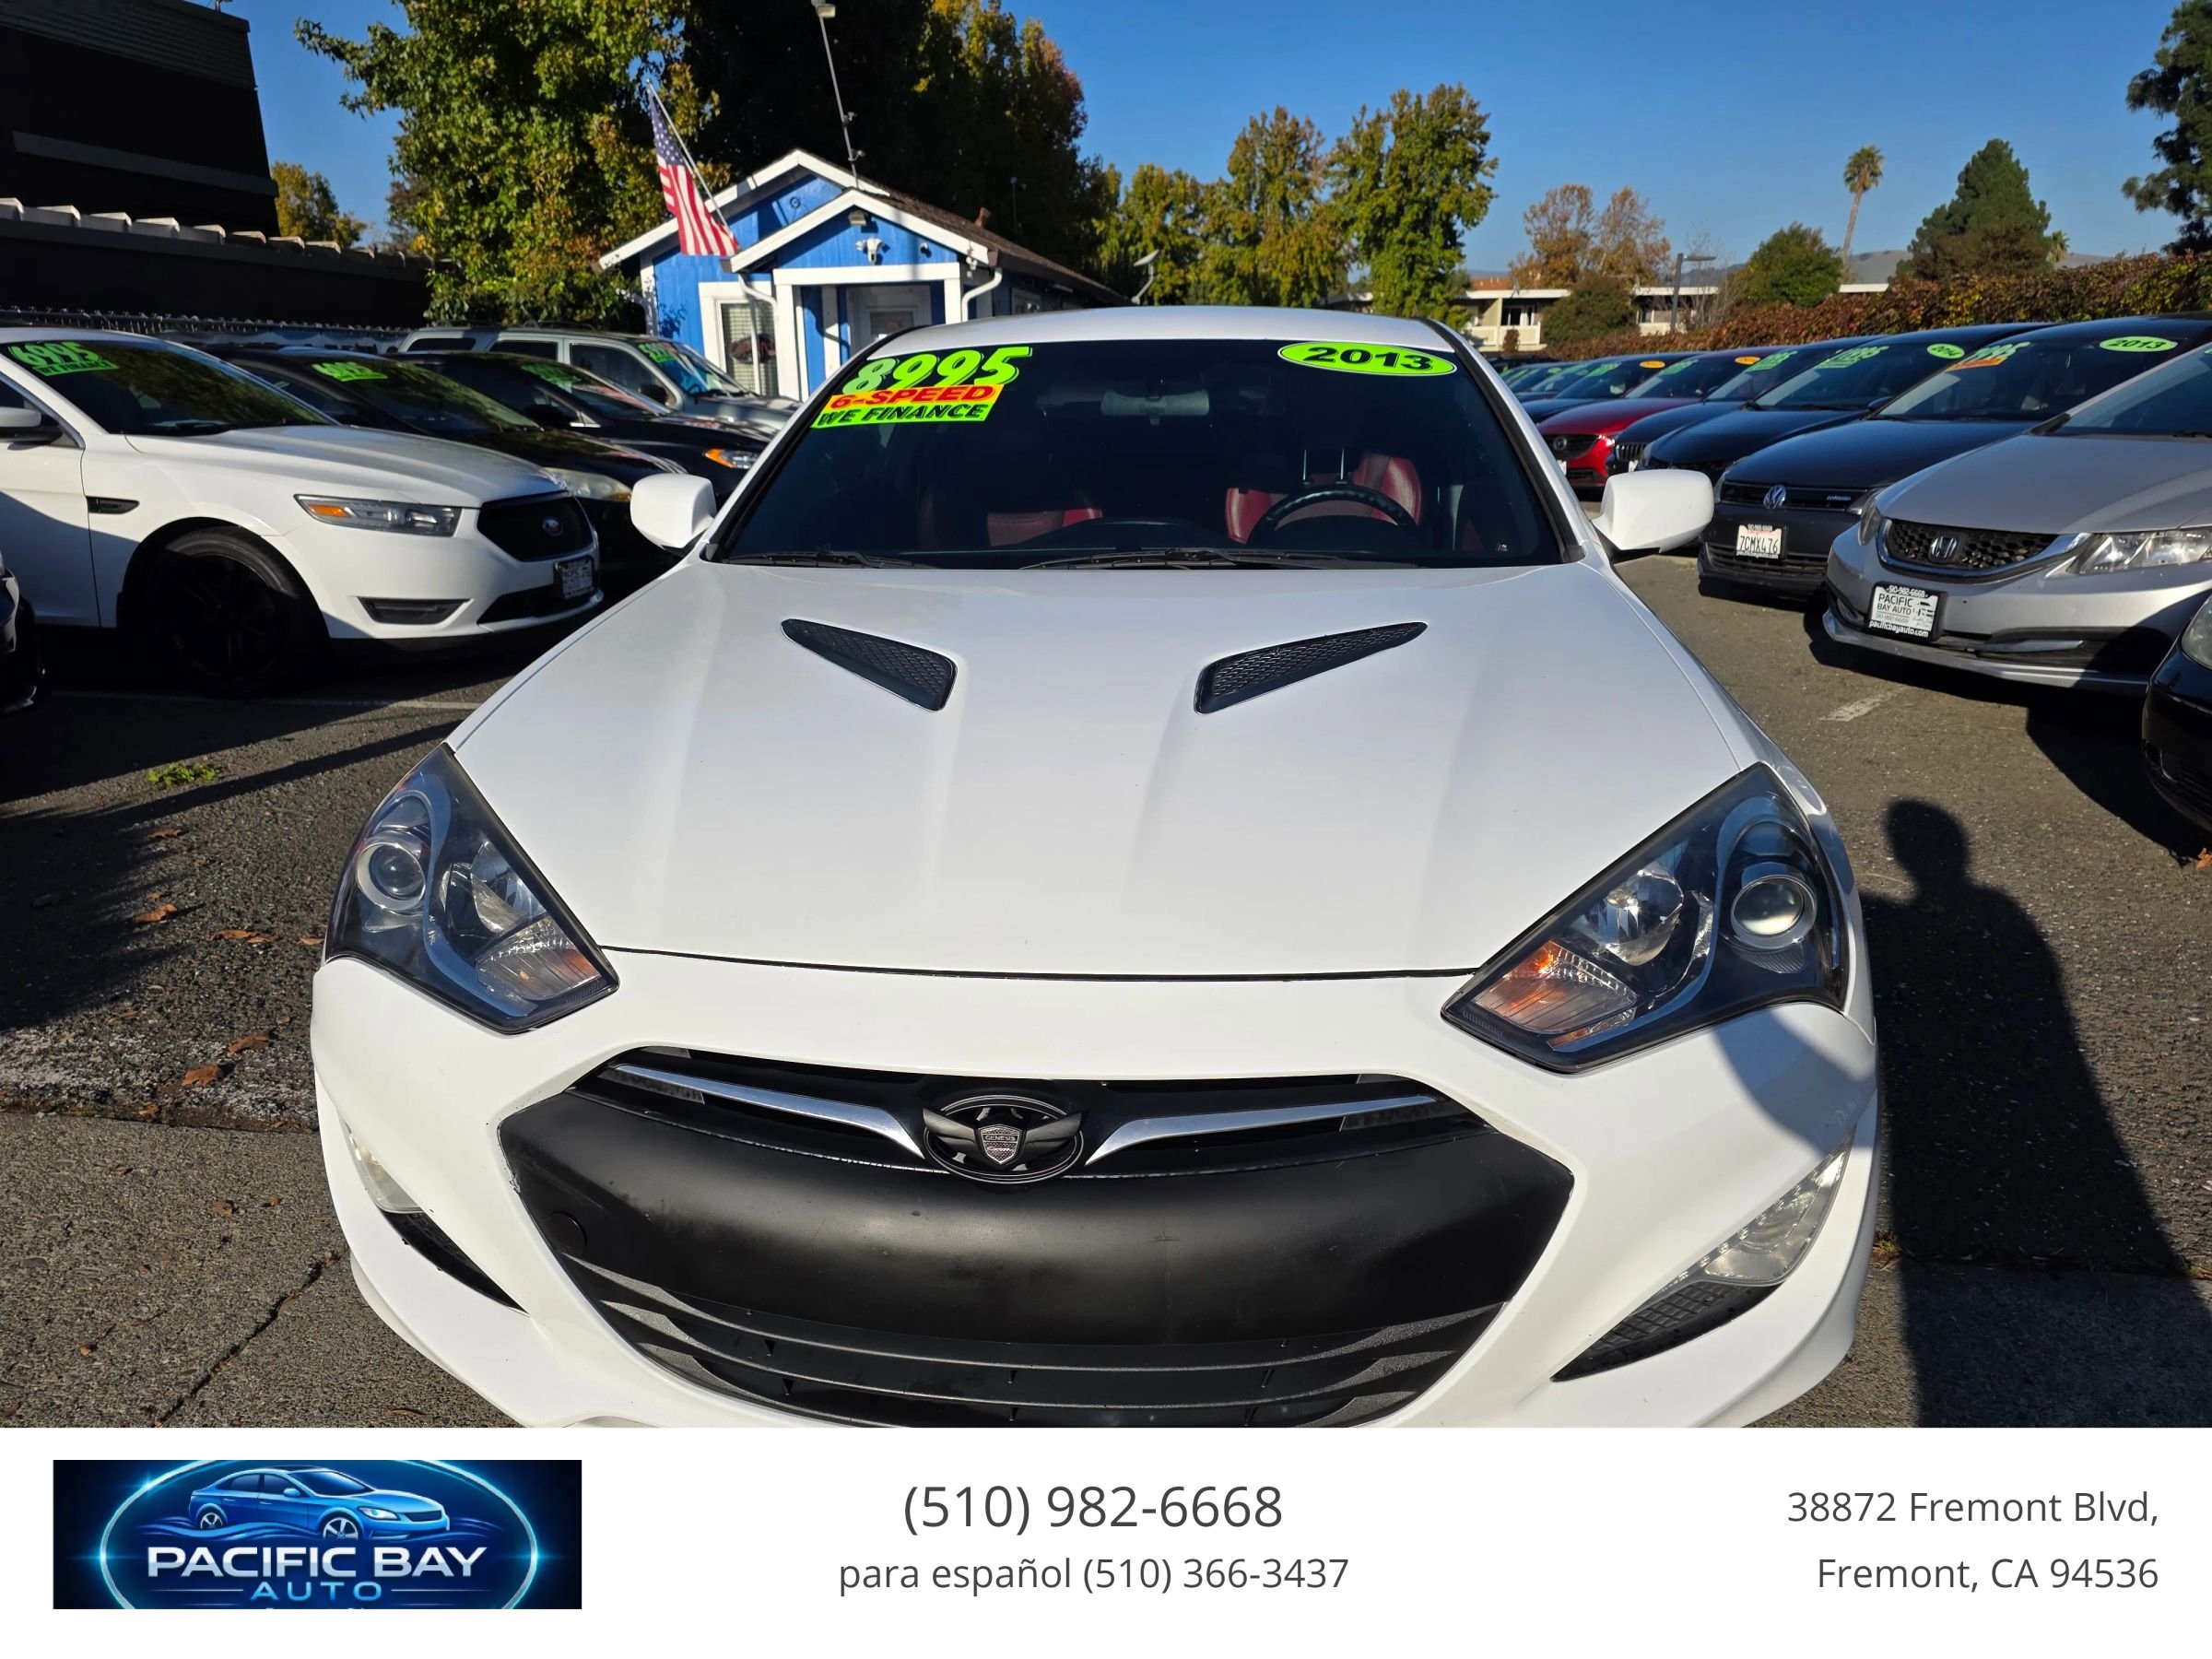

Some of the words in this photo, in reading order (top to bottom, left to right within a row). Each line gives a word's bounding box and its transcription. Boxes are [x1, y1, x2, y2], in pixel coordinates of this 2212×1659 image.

[7, 341, 102, 367] 6995
[2105, 339, 2167, 349] 2013
[1303, 347, 1433, 371] 2013
[841, 346, 1032, 394] 8995
[830, 385, 996, 409] 6-SPEED
[818, 408, 861, 425] WE
[862, 403, 989, 420] FINANCE
[1739, 535, 1779, 553] 7CMX476
[1877, 604, 1891, 612] BAY
[1892, 606, 1912, 616] AUTO
[1878, 593, 1913, 607] PACIFIC
[1869, 620, 1929, 637] pacificbayauto.com
